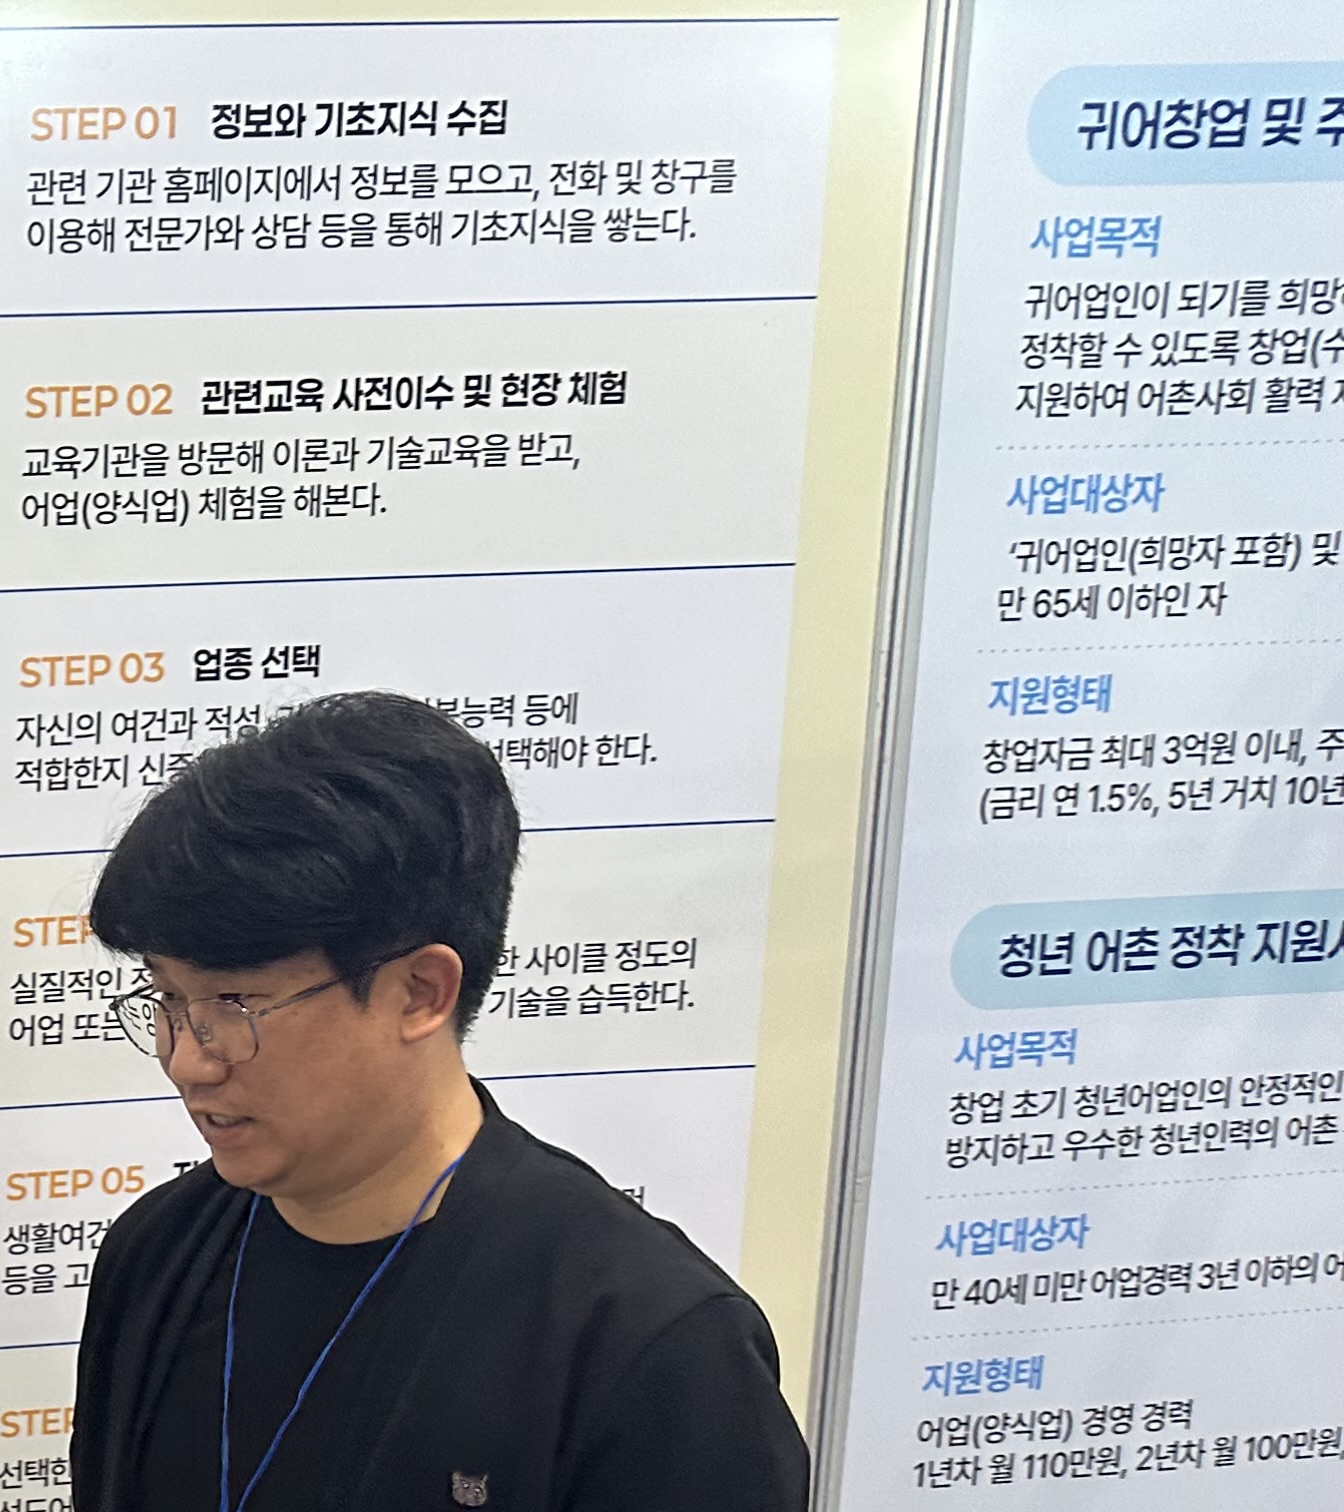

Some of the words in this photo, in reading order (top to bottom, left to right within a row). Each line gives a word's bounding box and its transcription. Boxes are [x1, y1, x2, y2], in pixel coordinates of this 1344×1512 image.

[31, 106, 127, 142] STEP
[134, 105, 177, 140] 01
[211, 102, 307, 140] 정보와
[314, 100, 438, 138] 기초지식
[446, 99, 508, 137] 수집
[1077, 98, 1251, 151] 귀어창업
[1261, 96, 1307, 147] 및
[26, 169, 87, 206] 관련
[95, 167, 157, 205] 기관
[163, 164, 342, 204] 홈페이지에서
[350, 163, 439, 201] 정보를
[445, 163, 540, 202] 모으고,
[549, 160, 608, 197] 전화
[615, 159, 643, 196] 및
[650, 158, 738, 195] 창구를
[27, 216, 116, 255] 이용해
[124, 214, 245, 253] 전문가와
[251, 213, 312, 250] 상담
[318, 212, 378, 249] 등을
[384, 210, 443, 248] 통해
[450, 208, 597, 246] 기초지식을
[603, 206, 696, 243] 쌓는다.
[1030, 215, 1162, 259] 사업목적
[1024, 281, 1171, 320] 귀어업인이
[1177, 279, 1271, 318] 되기를
[1020, 331, 1108, 370] 정착할
[1112, 332, 1143, 369] 수
[1150, 329, 1241, 368] 있도록
[25, 384, 119, 419] STEP
[126, 383, 173, 417] 02
[201, 377, 325, 416] 관련교육
[332, 374, 454, 412] 사전이수
[463, 373, 492, 409] 및
[501, 372, 562, 408] 현장
[567, 370, 628, 406] 체험
[21, 442, 170, 480] 교육기관을
[178, 439, 265, 477] 방문해
[273, 436, 361, 474] 이론과
[366, 433, 511, 471] 기술교육을
[518, 431, 580, 470] 받고,
[21, 488, 190, 530] 어업(양식업)
[198, 485, 286, 522] 체험을
[293, 482, 387, 519] 해본다.
[1006, 472, 1166, 516] 사업대상자
[1230, 532, 1302, 572] 포함)
[1312, 530, 1342, 567] 및
[19, 654, 112, 689] STEP
[119, 651, 165, 684] 03
[193, 647, 253, 682] 업종
[261, 644, 321, 680] 선택
[988, 673, 1113, 717] 지원형태
[15, 710, 102, 748] 자신의
[111, 706, 199, 744] 여건과
[523, 692, 579, 727] 등에
[15, 754, 129, 793] 적합한지
[595, 732, 658, 767] 한다.
[10, 967, 122, 1005] 실질적인
[524, 942, 609, 976] 사이클
[614, 937, 697, 972] 정도의
[999, 931, 1075, 979] 청년
[1086, 926, 1160, 973] 어촌
[1170, 923, 1246, 970] 정착
[9, 1012, 64, 1047] 어업
[488, 985, 572, 1019] 기술을
[577, 979, 695, 1015] 습득한다.
[954, 1028, 1078, 1071] 사업목적
[949, 1090, 1005, 1126] 창업
[1010, 1086, 1067, 1120] 초기
[1073, 1076, 1233, 1118] 청년어업인의
[1239, 1070, 1344, 1108] 안정적인
[6, 1168, 94, 1202] STEP
[101, 1165, 145, 1195] 05
[935, 1213, 1091, 1258] 사업대상자
[2, 1263, 57, 1295] 등을
[922, 1354, 1045, 1397] 지원형태
[917, 1408, 1074, 1450] 어업(양식업)
[1081, 1403, 1135, 1437] 경영
[1141, 1399, 1194, 1433] 경력
